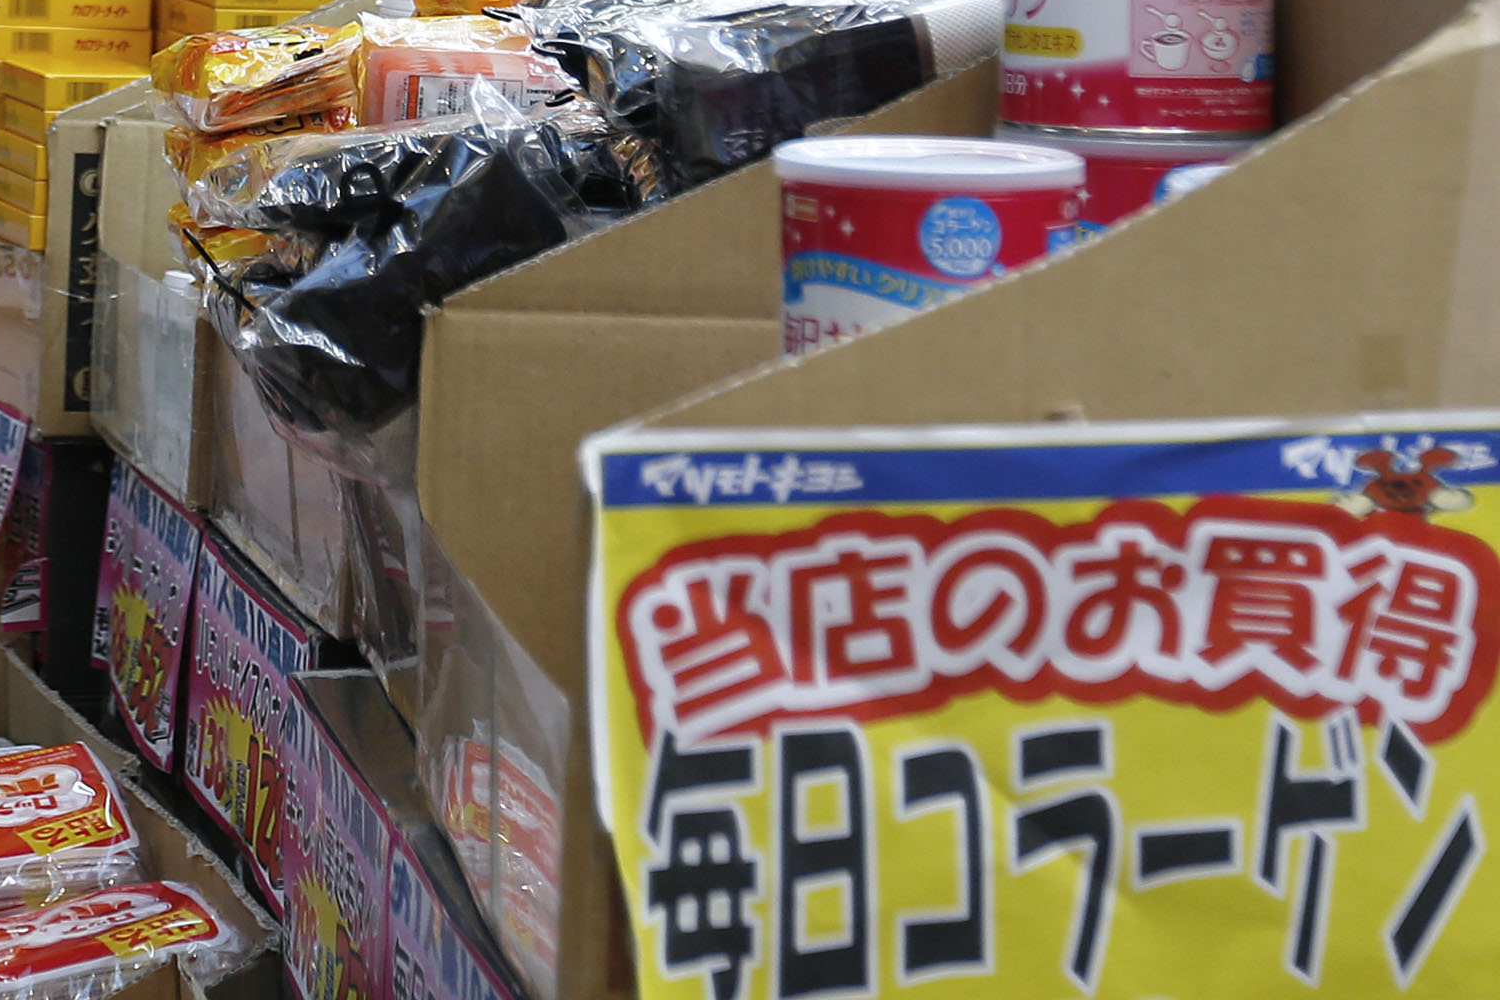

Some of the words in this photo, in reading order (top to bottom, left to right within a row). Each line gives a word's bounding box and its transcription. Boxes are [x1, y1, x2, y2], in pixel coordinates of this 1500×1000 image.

[640, 453, 866, 503] マツモトキヨシ
[650, 533, 1464, 720] 当店のお買得
[645, 712, 1485, 1000] 毎日コラーゲン
